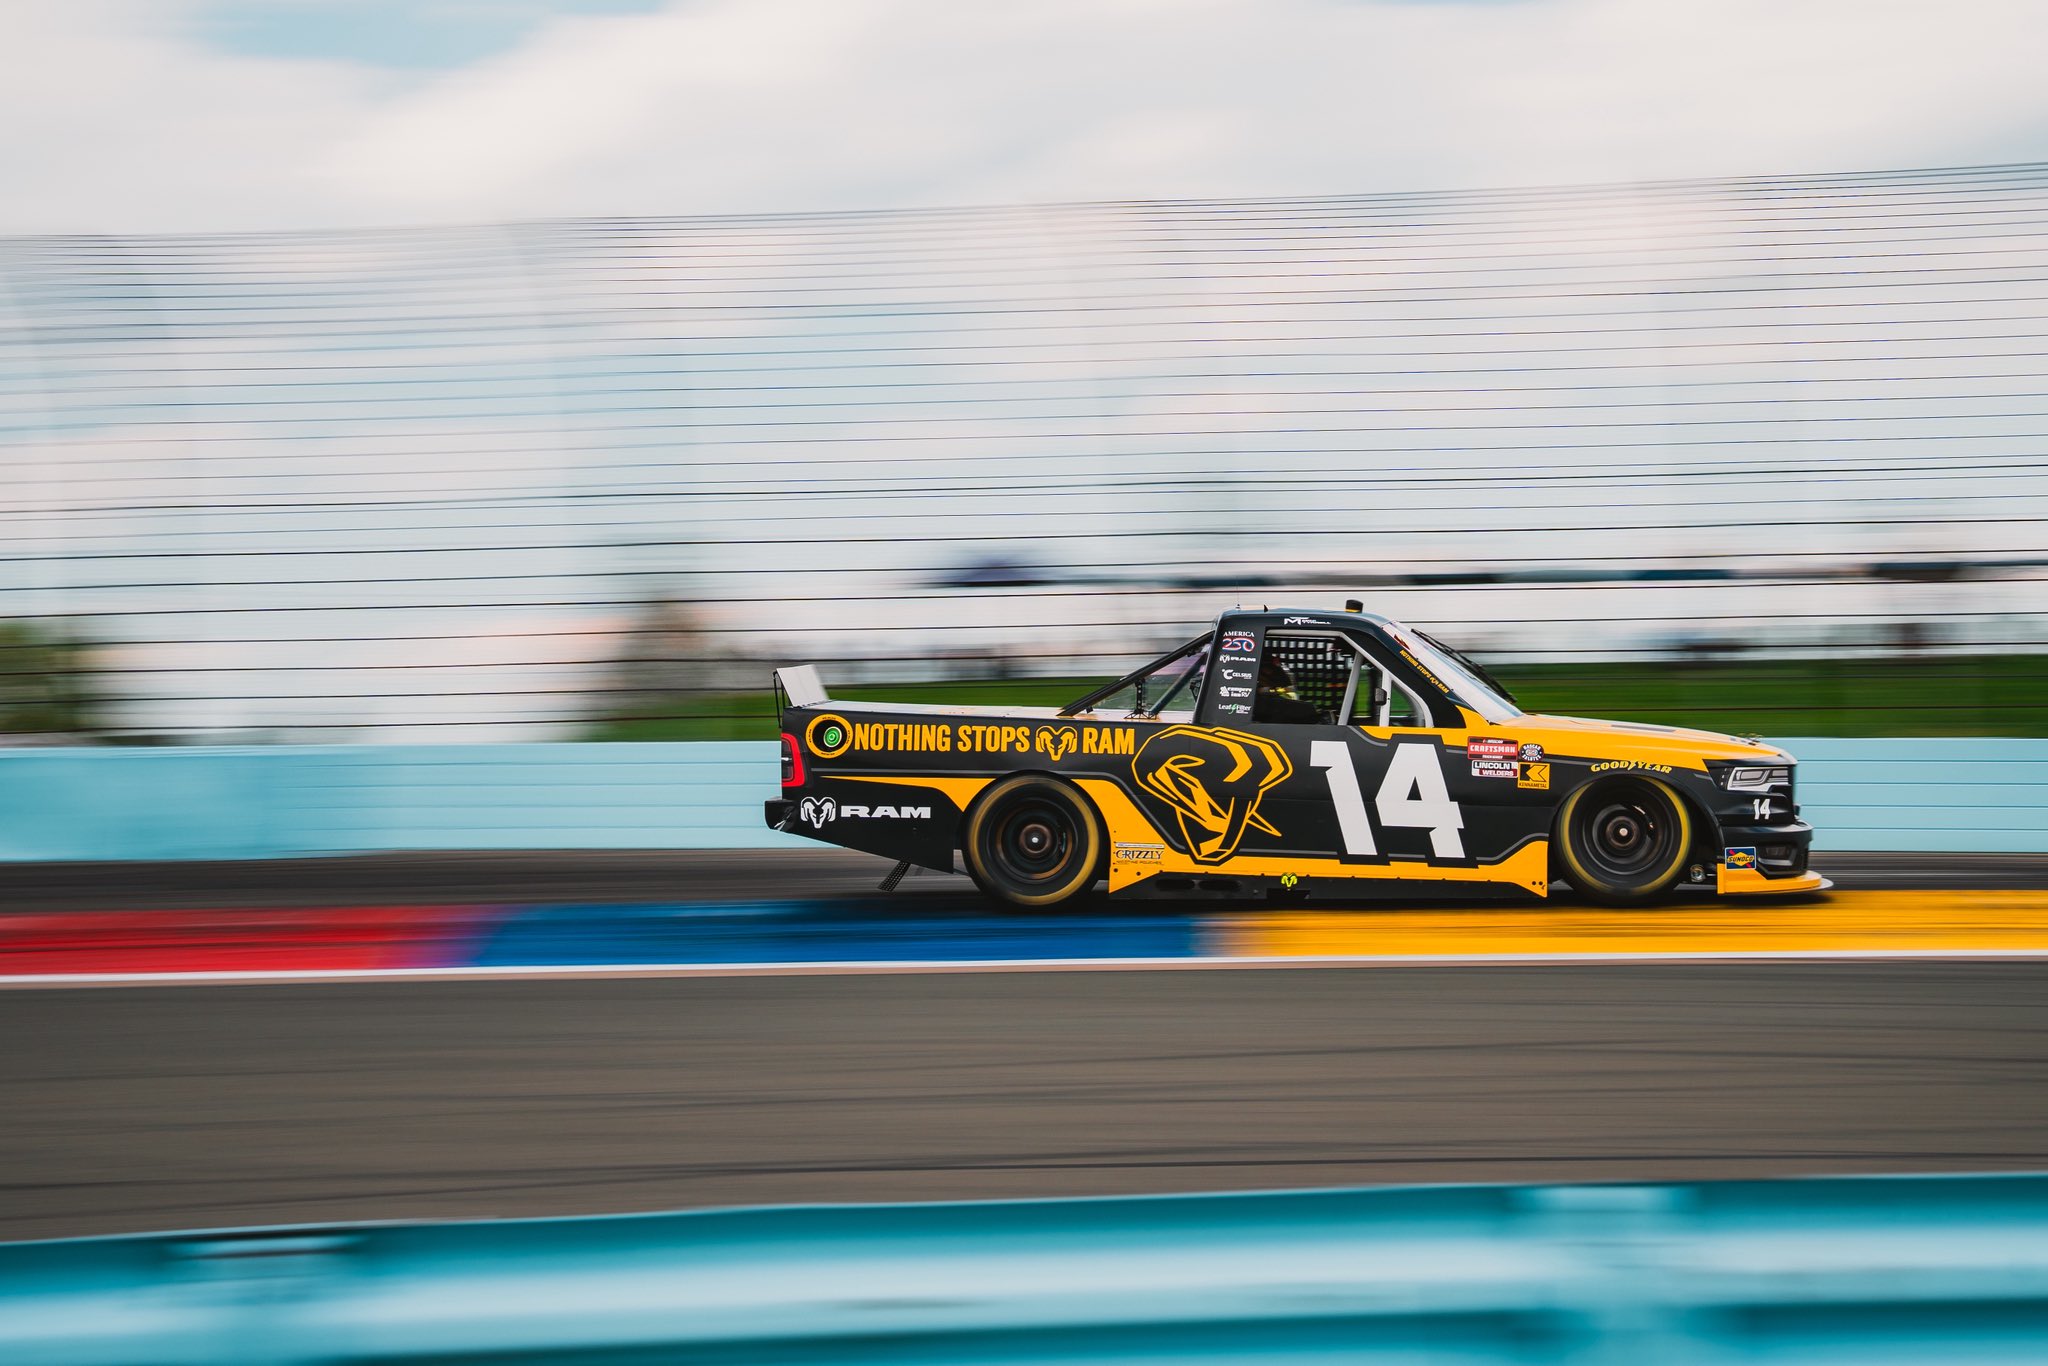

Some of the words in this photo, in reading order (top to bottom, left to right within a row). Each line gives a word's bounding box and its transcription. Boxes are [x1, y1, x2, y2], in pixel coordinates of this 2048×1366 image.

[1222, 638, 1255, 652] 250
[854, 723, 950, 751] NOTHING
[957, 725, 1030, 752] STOPS
[1082, 727, 1135, 755] RAM
[1470, 745, 1516, 753] CRAFTSMAN
[1474, 761, 1510, 769] LINCOLN
[1591, 760, 1672, 774] GOODYEAR
[1310, 740, 1465, 858] 14
[841, 805, 931, 819] RAM
[1753, 798, 1771, 820] 14
[1116, 850, 1164, 860] GRIZZLY
[1728, 855, 1754, 863] SUNOCO
